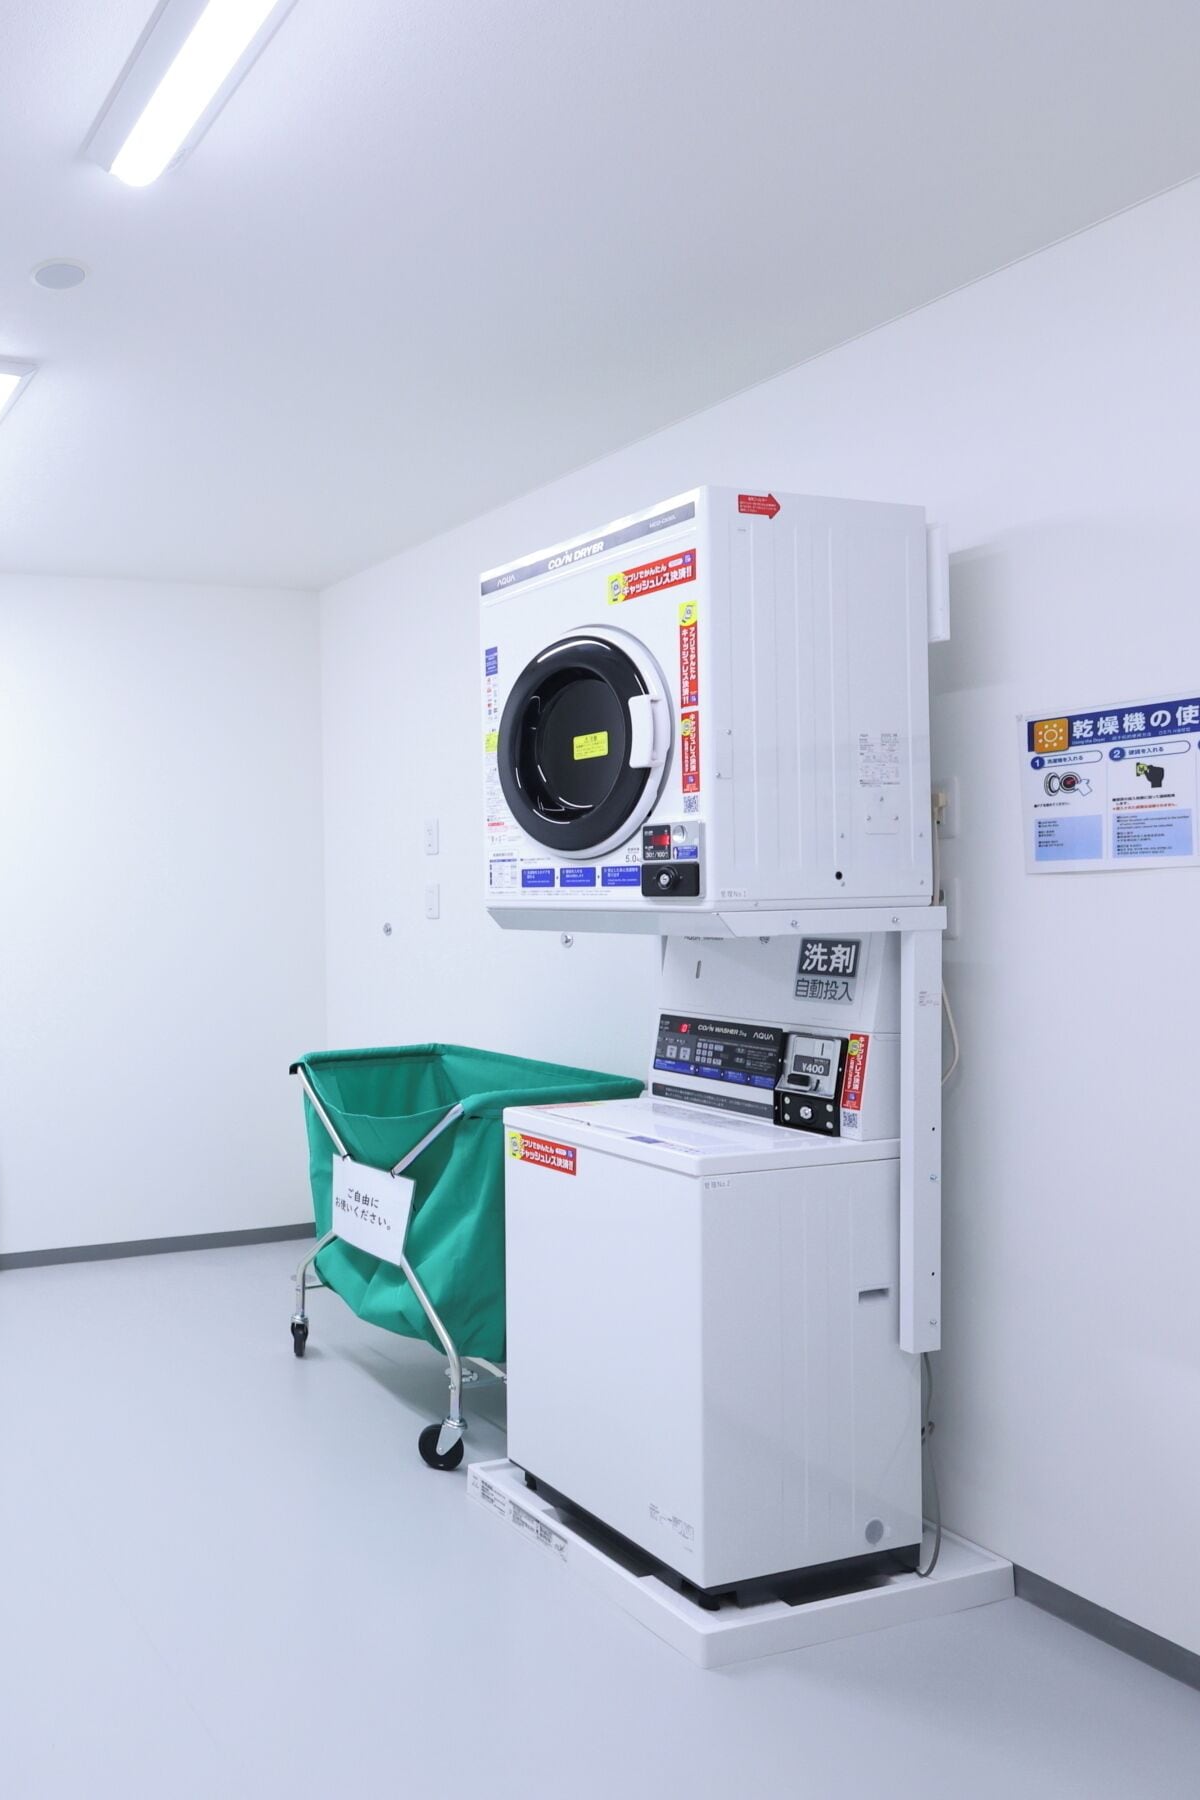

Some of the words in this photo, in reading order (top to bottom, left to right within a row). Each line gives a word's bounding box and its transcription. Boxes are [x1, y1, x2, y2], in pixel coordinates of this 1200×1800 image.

[574, 541, 605, 561] DRYER
[496, 574, 516, 587] AQUA
[1113, 750, 1121, 758] 2
[802, 942, 857, 974] 洗剤
[794, 978, 853, 1002] 自動投入
[715, 1027, 739, 1035] WASHER
[753, 1031, 774, 1041] AQUA
[802, 1062, 824, 1074] ¥400
[347, 1187, 380, 1209] ご自由に
[335, 1196, 392, 1231] お使いください。
